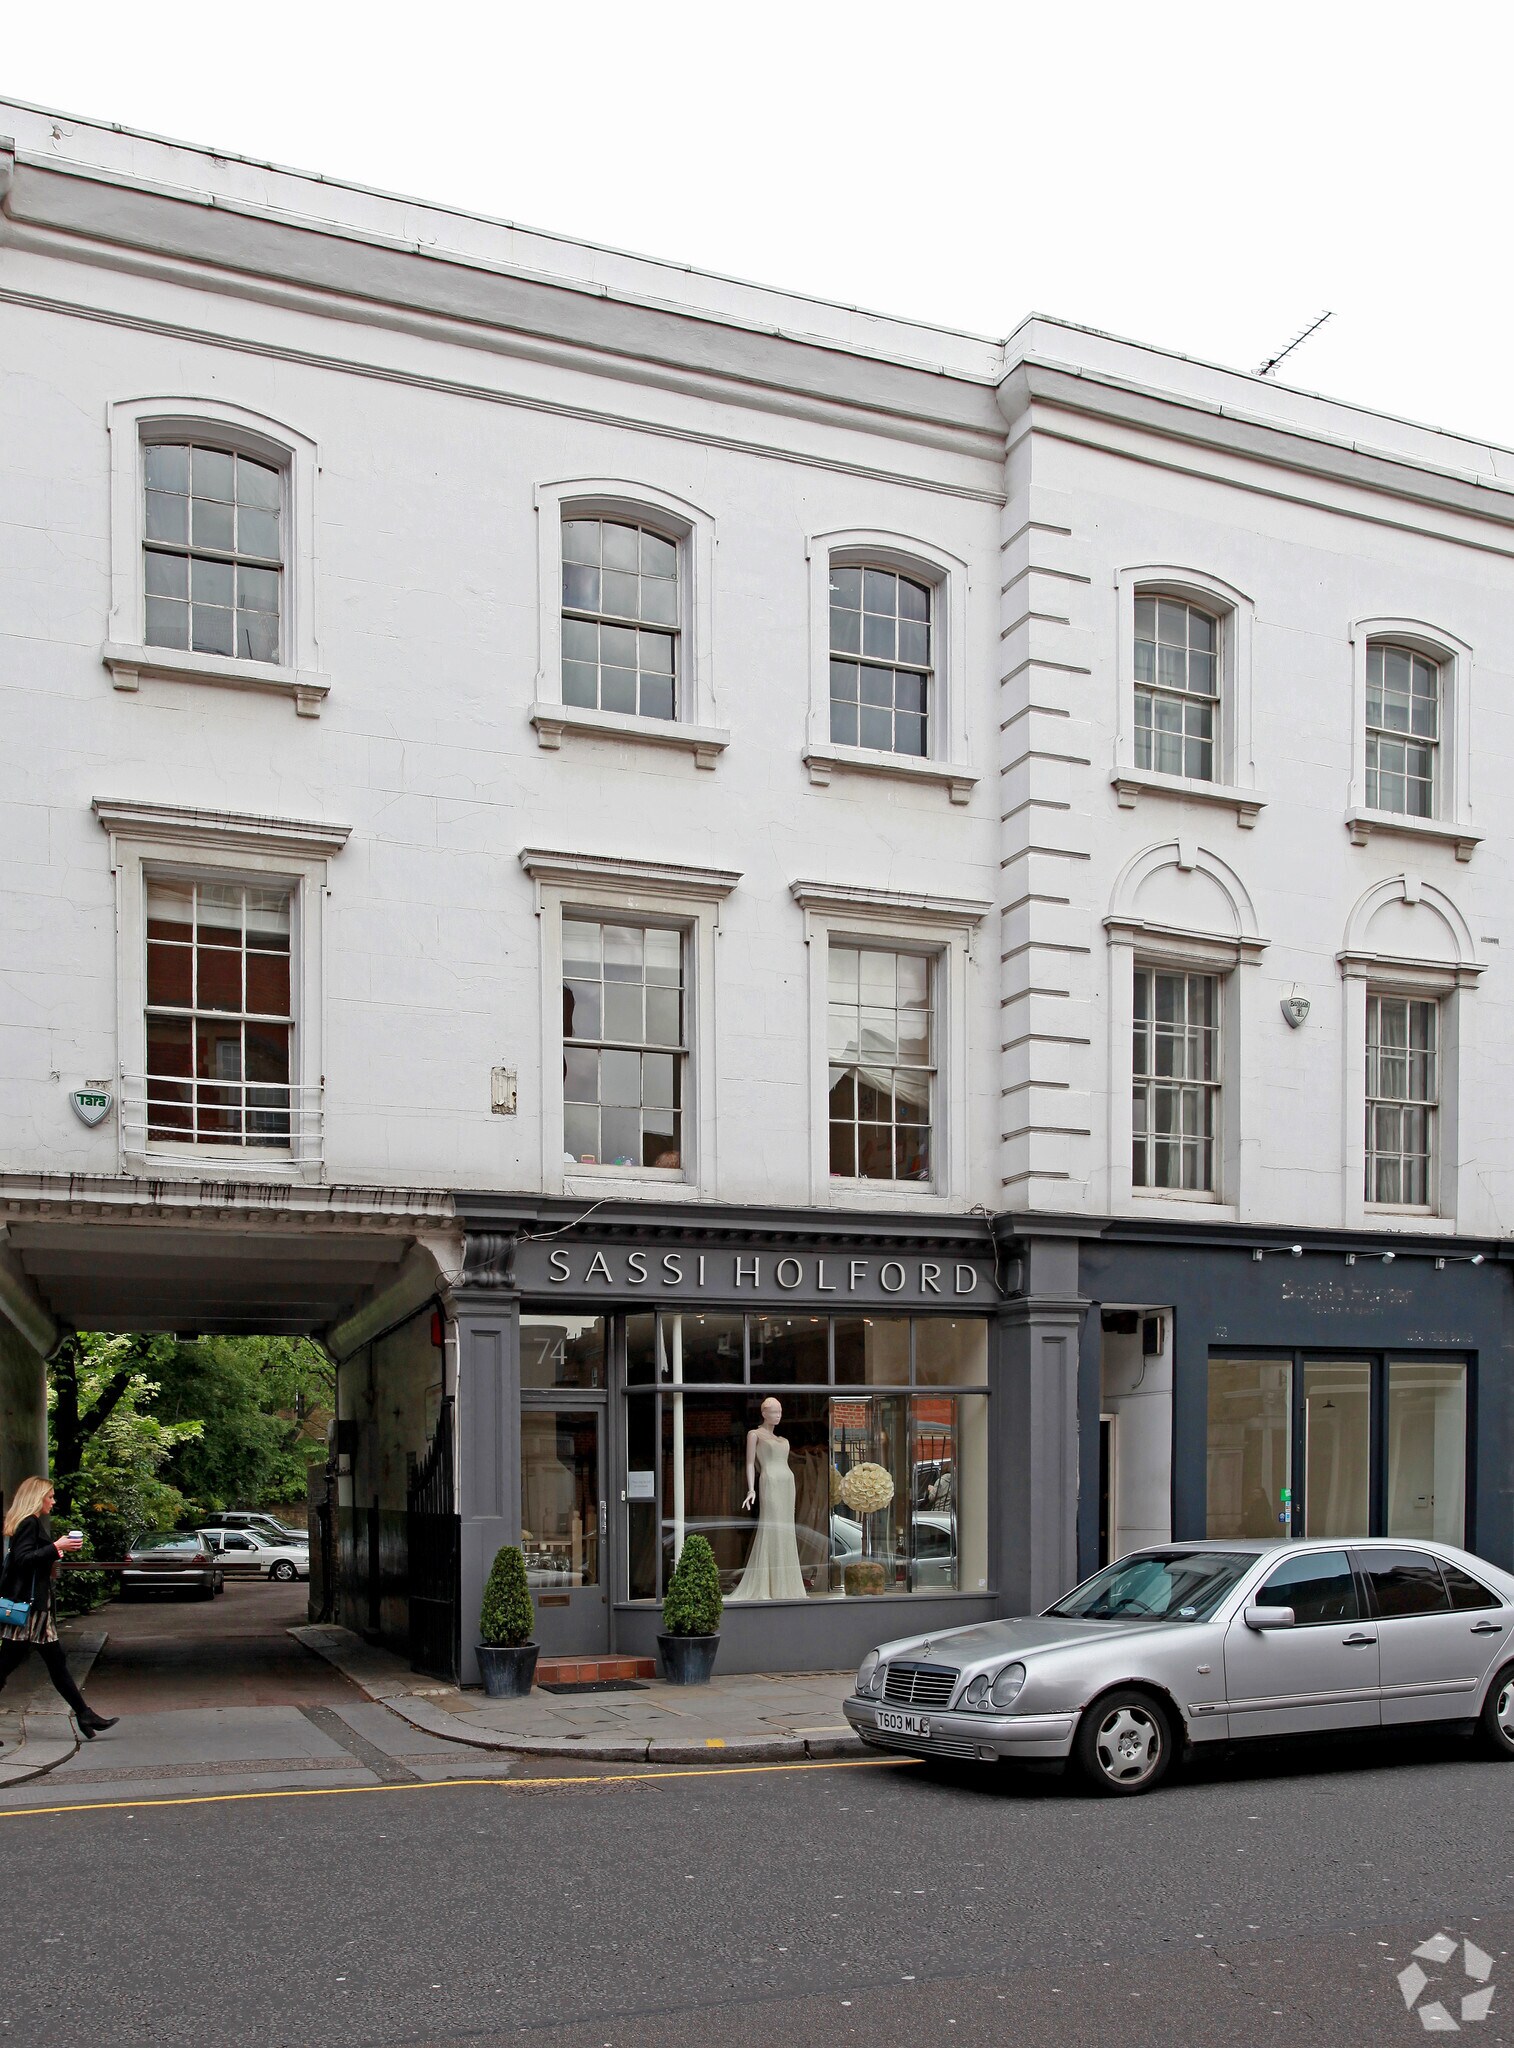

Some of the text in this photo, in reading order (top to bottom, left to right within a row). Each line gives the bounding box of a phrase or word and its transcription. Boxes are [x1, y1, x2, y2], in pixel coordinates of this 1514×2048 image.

[77, 1094, 107, 1107] Tara
[550, 1250, 978, 1294] SASSI HOLFORD
[534, 1338, 568, 1365] 74
[878, 1712, 903, 1729] T603
